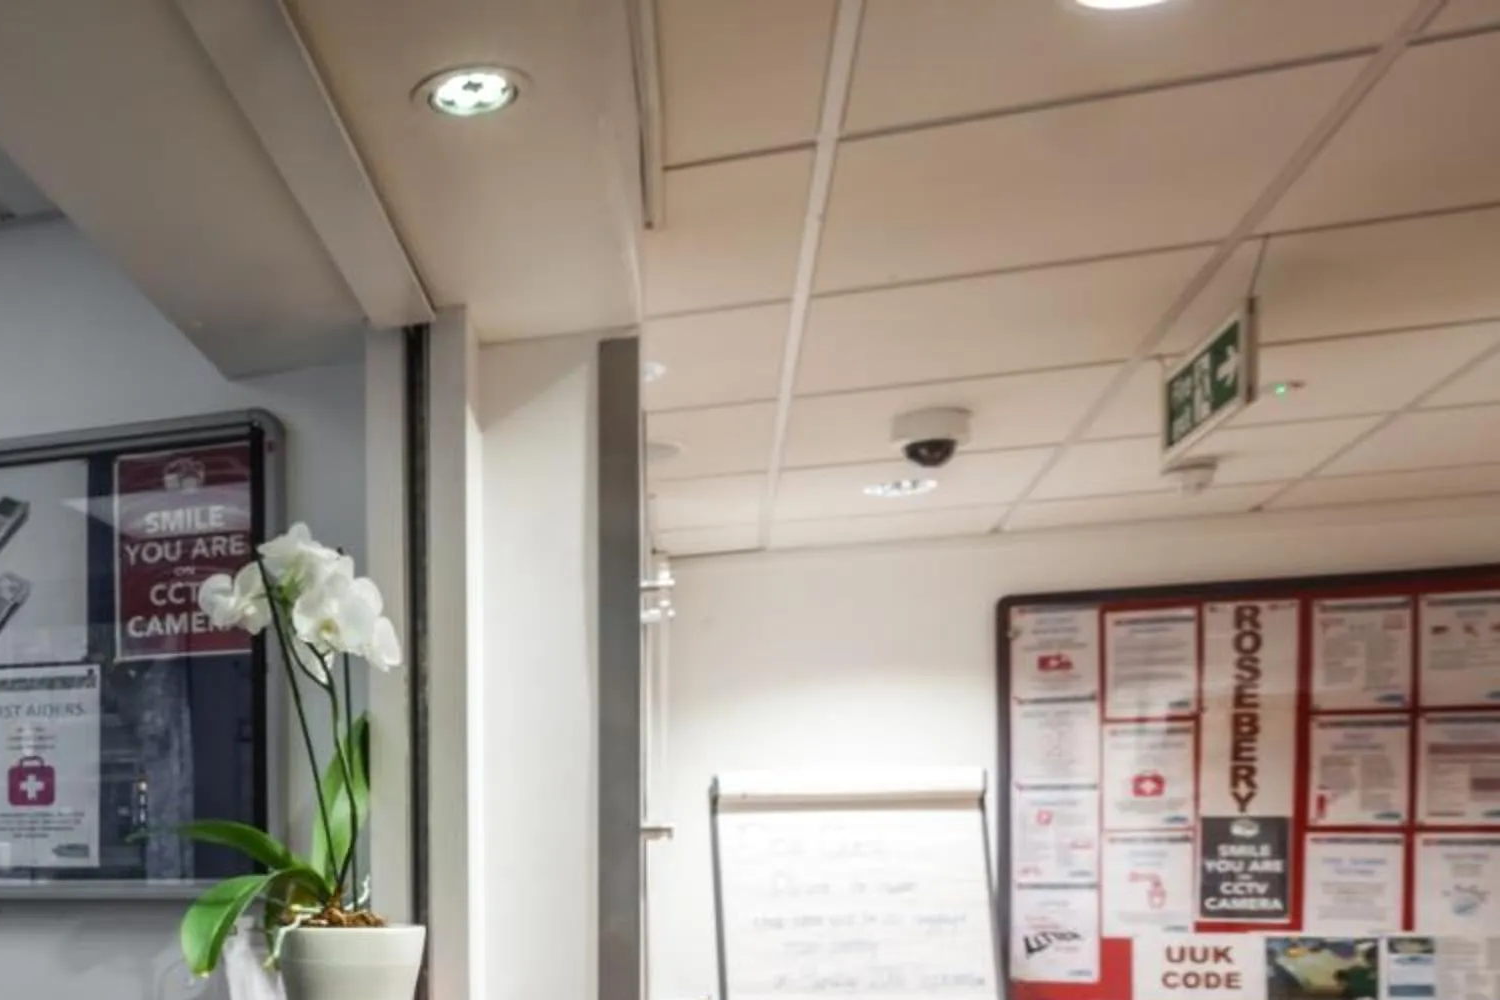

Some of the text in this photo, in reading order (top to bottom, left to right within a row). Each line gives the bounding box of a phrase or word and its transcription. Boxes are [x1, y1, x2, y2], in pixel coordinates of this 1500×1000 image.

[144, 505, 226, 534] SMILE
[124, 534, 246, 566] YOU ARE
[150, 582, 202, 607] CCT
[127, 612, 233, 638] CAME
[1230, 604, 1263, 814] ROSEBERY
[1205, 859, 1244, 873] YOU
[1220, 881, 1269, 895] CCTV
[1165, 946, 1234, 965] UUK
[1161, 971, 1242, 990] CODE
